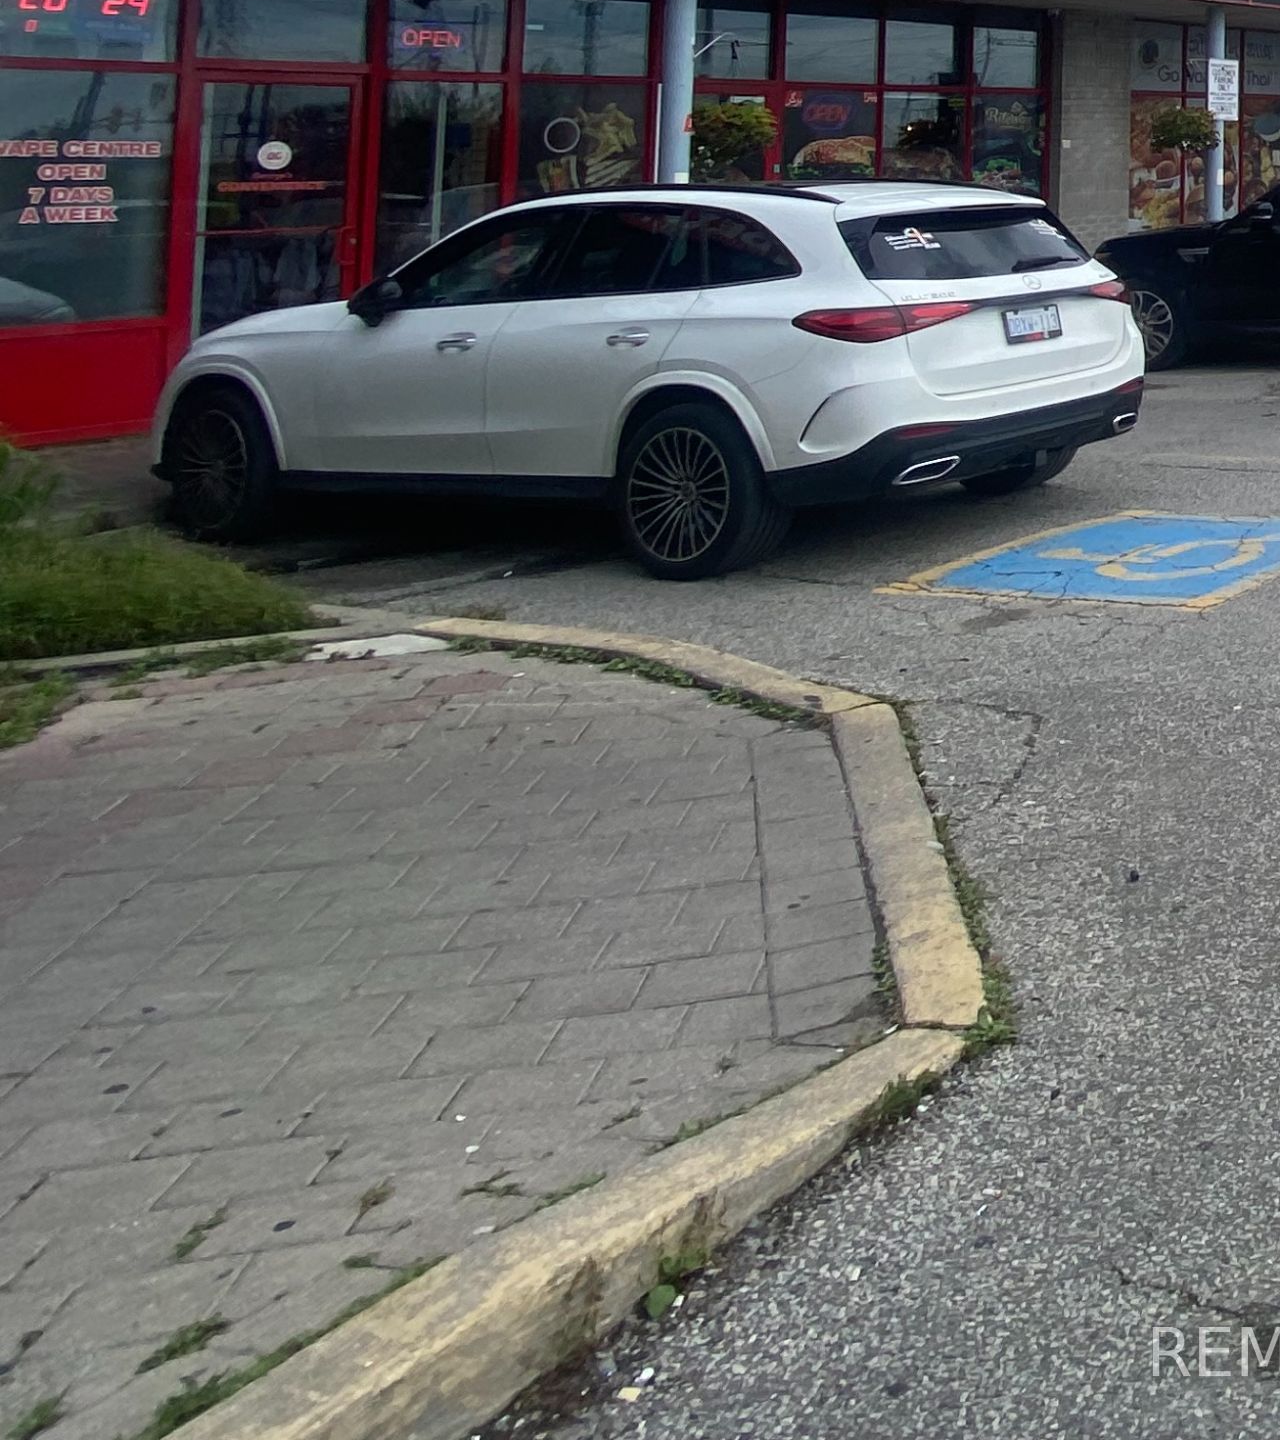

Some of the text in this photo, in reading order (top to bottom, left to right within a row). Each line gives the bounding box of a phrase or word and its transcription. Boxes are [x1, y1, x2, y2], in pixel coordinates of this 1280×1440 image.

[402, 27, 461, 49] OPEN
[0, 140, 161, 157] VAPE CENTRE
[37, 164, 106, 180] OPEN
[28, 186, 113, 204] 7 DAYS
[19, 206, 118, 224] A WEEK
